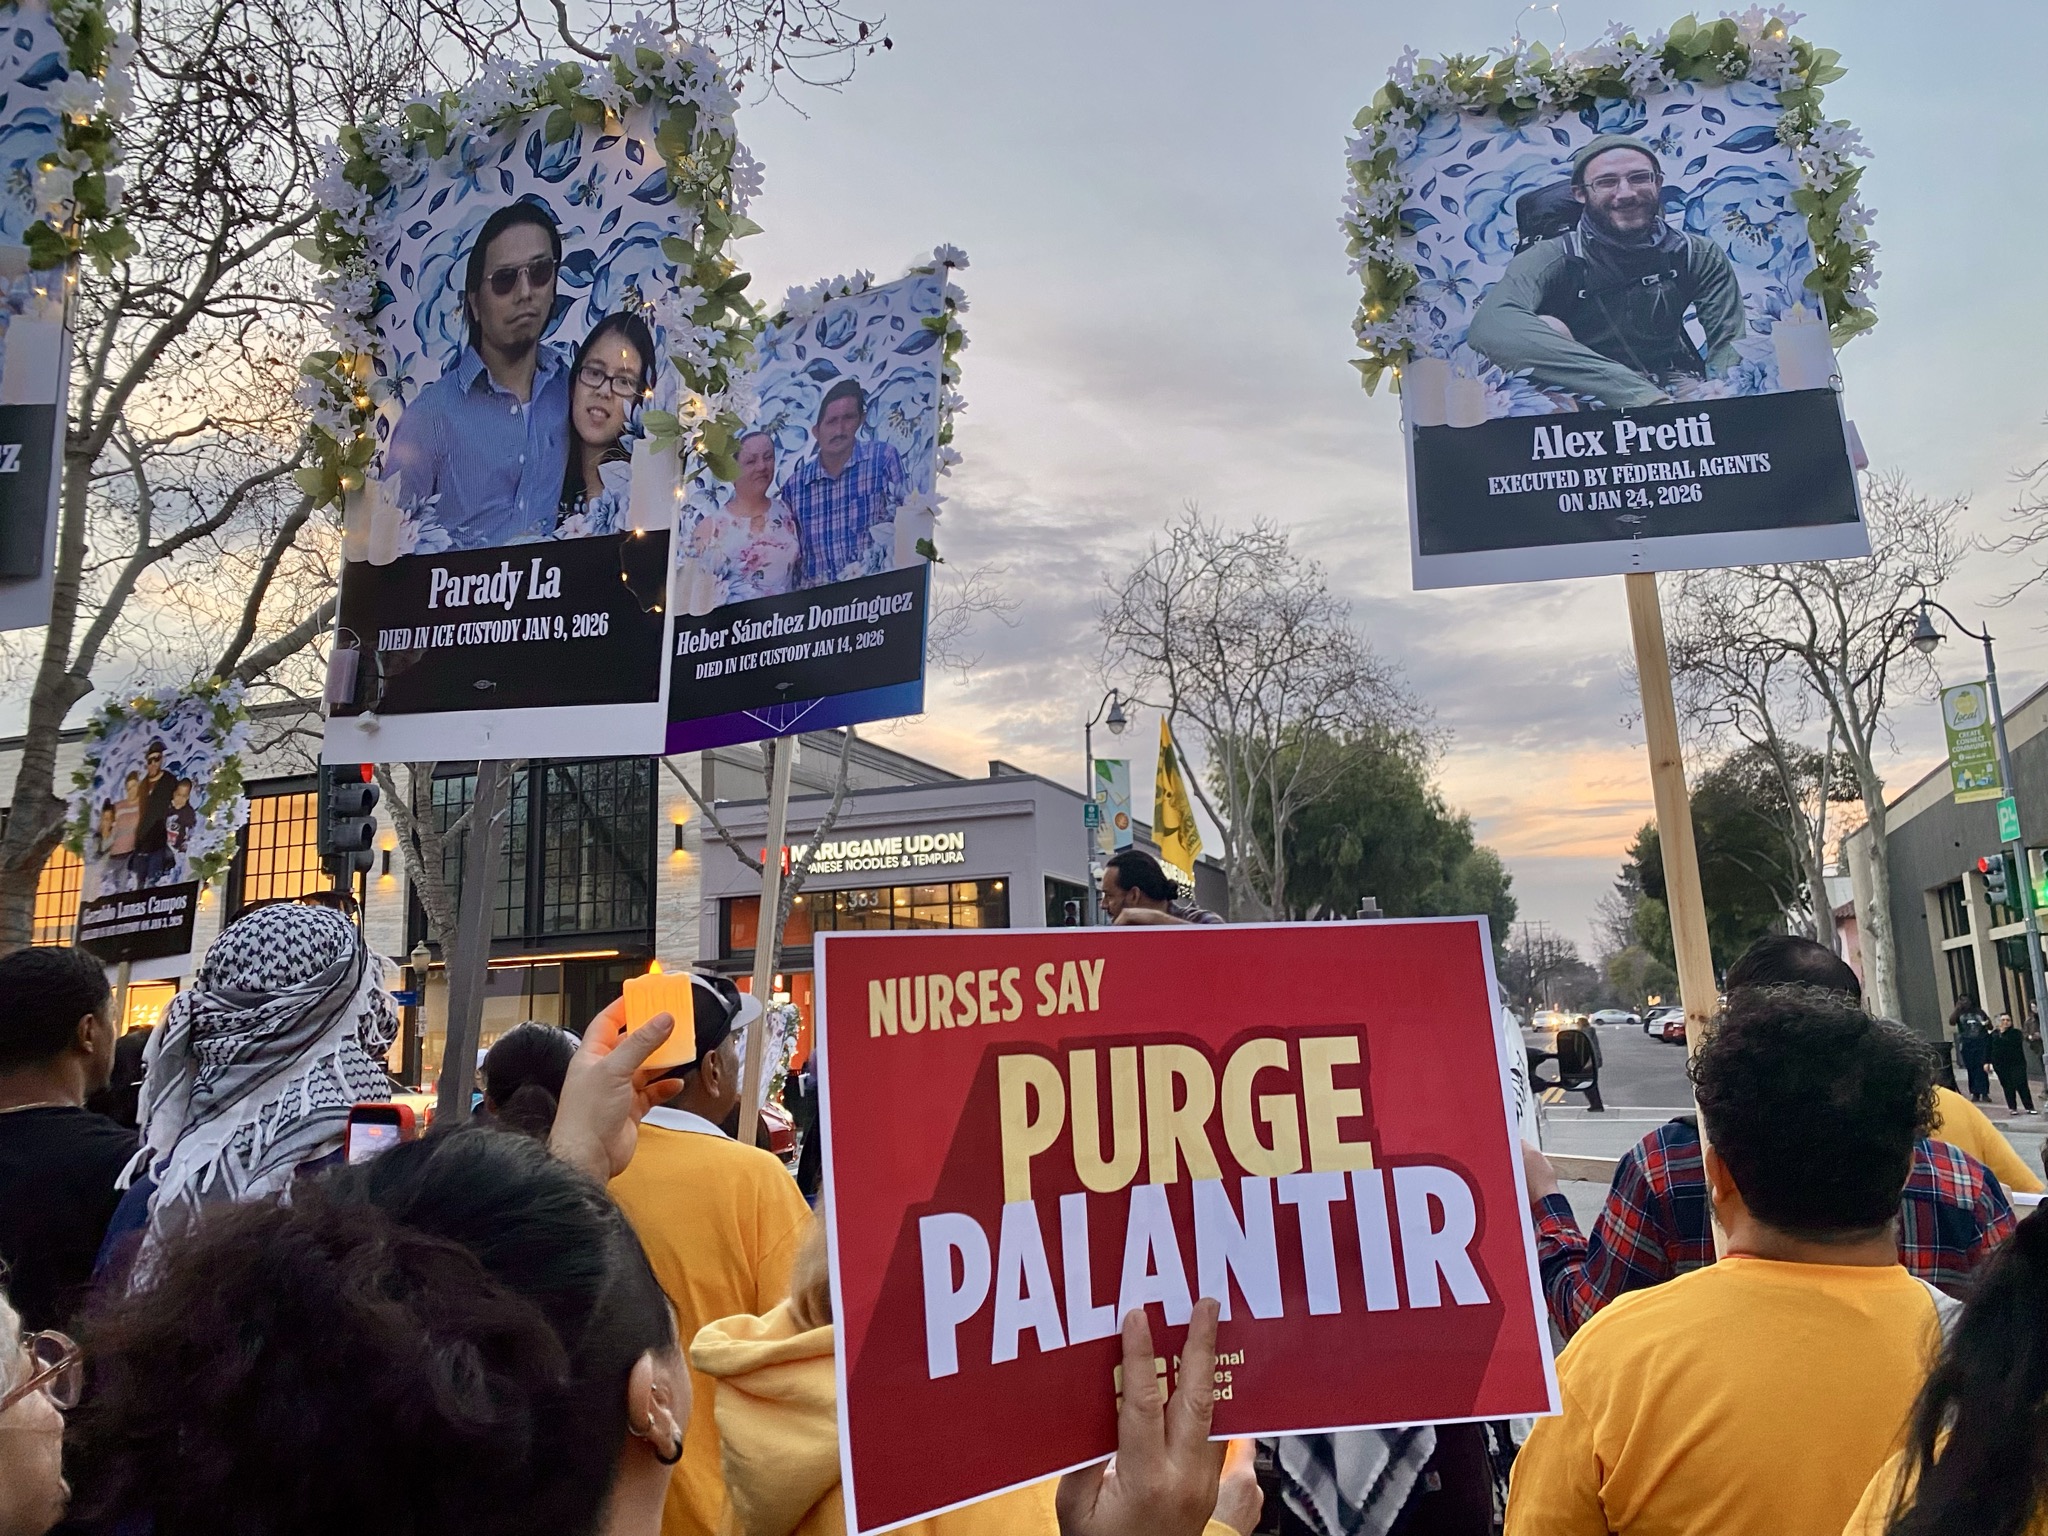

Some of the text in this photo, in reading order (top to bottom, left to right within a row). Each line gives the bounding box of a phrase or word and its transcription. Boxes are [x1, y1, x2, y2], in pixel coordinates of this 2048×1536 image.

[1531, 412, 1715, 461] Alex Pretti
[1488, 453, 1771, 496] EXECUTED BY FEDERAL AGENTS
[1558, 483, 1703, 513] ON JAN 24, 2026
[428, 557, 561, 611] Parady La
[378, 612, 610, 652] DIED IN ICE CUSTODY JAN 9, 2026
[677, 591, 913, 656] Heber Sánchez Domínguez
[695, 629, 884, 680] DIED IN ICE CUSTODY JAN 14, 2026
[1953, 708, 1978, 726] Local
[1952, 741, 1992, 753] COMMUNITY
[1956, 735, 1985, 746] CONNECT
[1958, 729, 1981, 738] CREATE
[903, 831, 965, 854] UDON
[791, 850, 965, 876] ANESE NOODLES & TEMPURA
[148, 895, 188, 914] Campos
[848, 890, 879, 908] 383
[868, 959, 1105, 1038] NURSES SAY
[997, 1036, 1375, 1205] PURGE
[918, 1166, 1491, 1380] PALANTIR
[1173, 1349, 1245, 1369] Nnal
